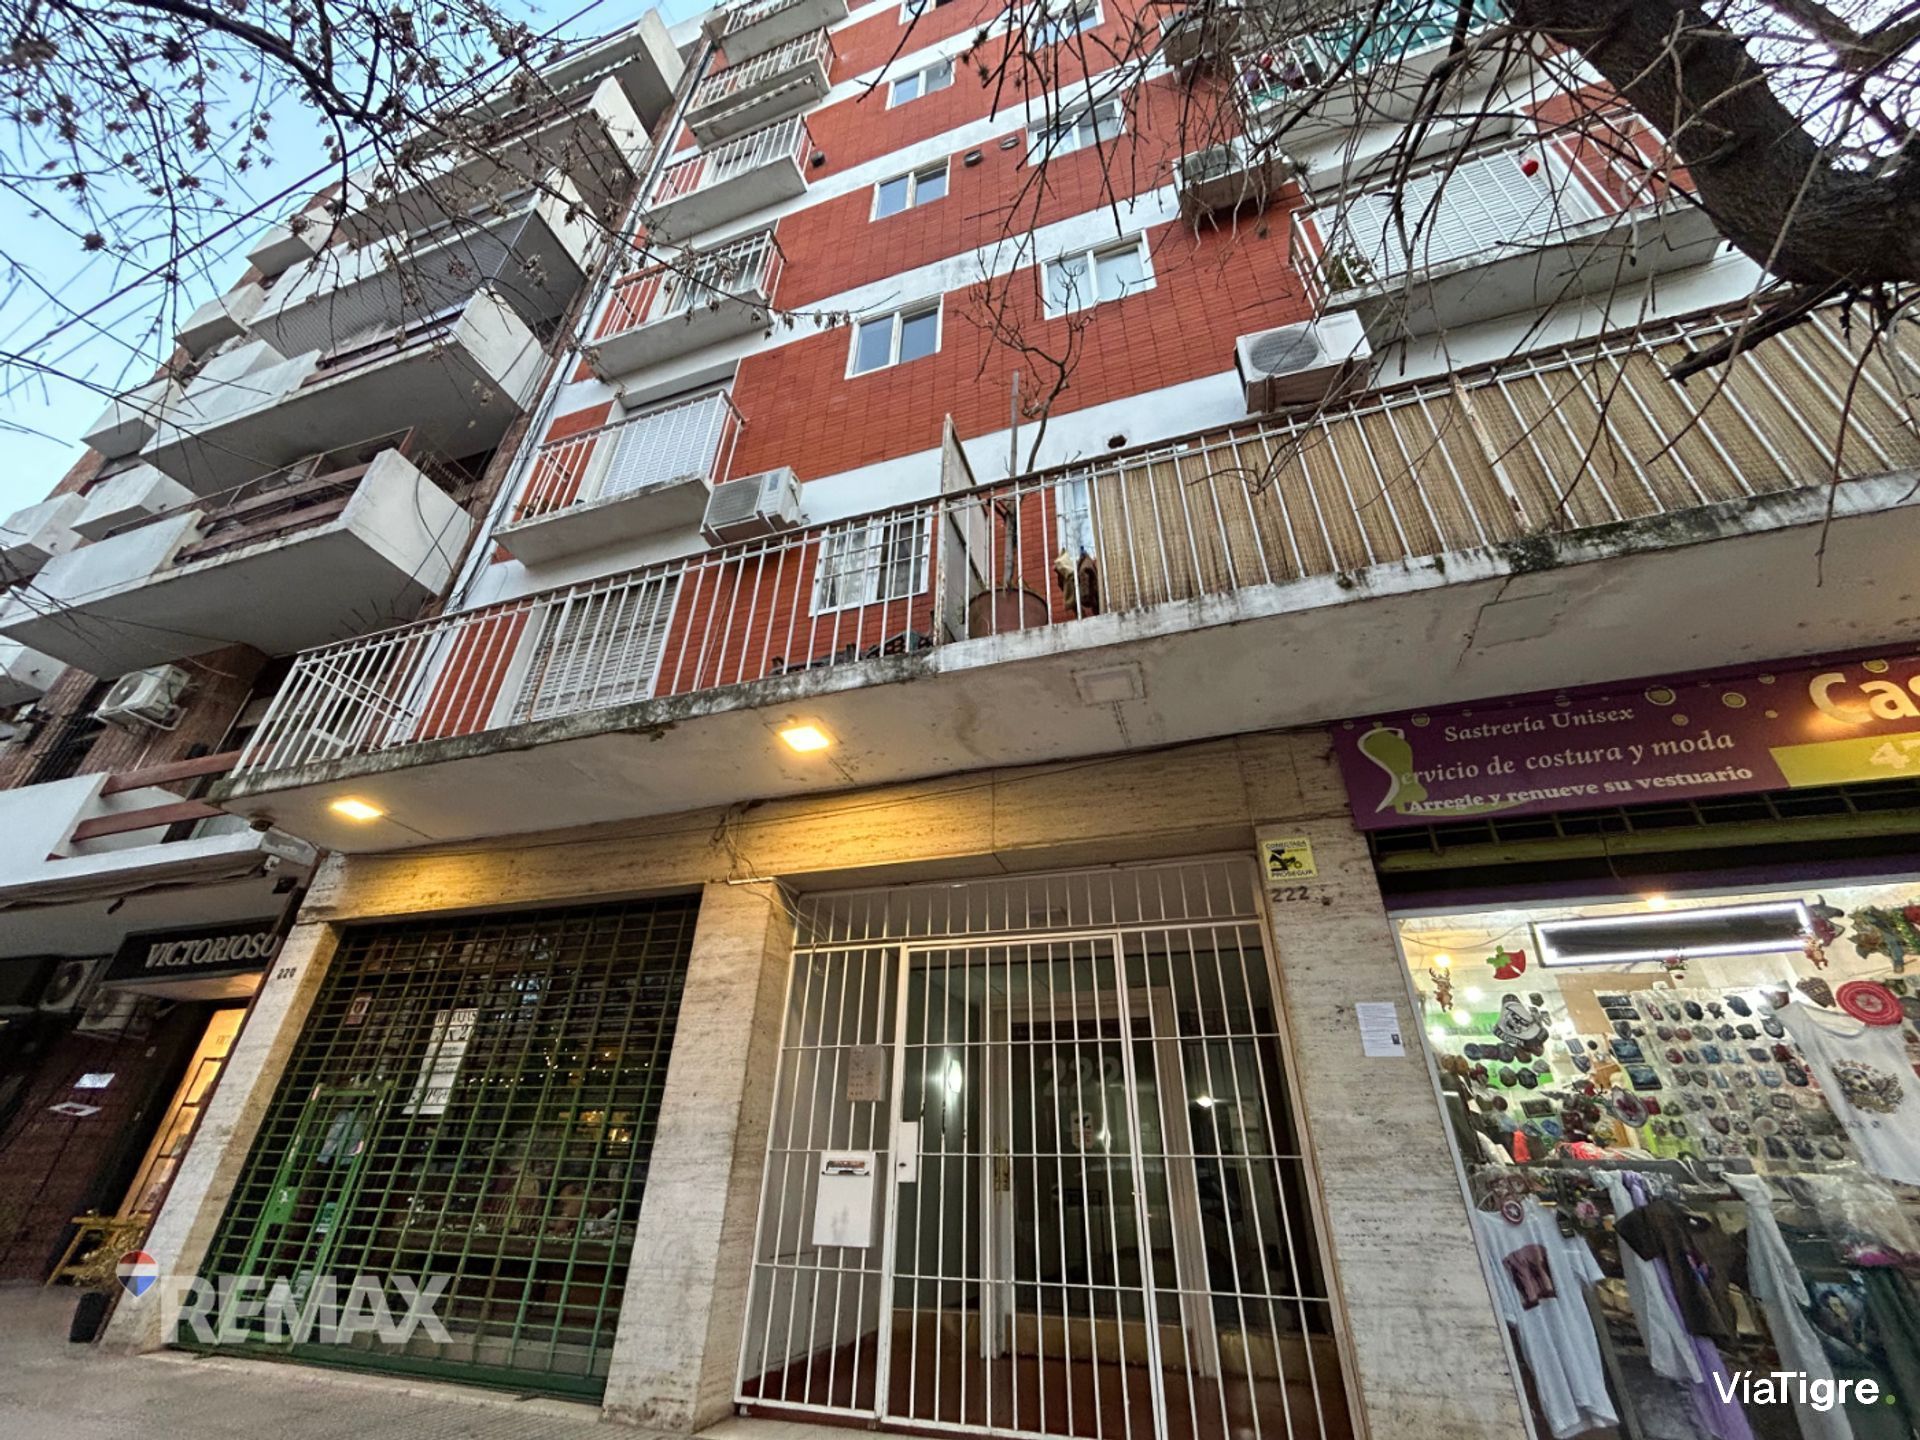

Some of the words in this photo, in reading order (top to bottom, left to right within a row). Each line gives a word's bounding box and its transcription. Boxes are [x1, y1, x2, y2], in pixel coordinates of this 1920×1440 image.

[1444, 716, 1546, 743] Sastrería
[1551, 707, 1635, 729] Unisex
[1487, 755, 1516, 777] de
[1526, 746, 1623, 770] costura
[1628, 743, 1644, 766] y
[1651, 729, 1736, 757] moda
[1409, 793, 1485, 814] Arregle
[1488, 792, 1503, 807] y
[1505, 781, 1600, 804] renueve
[1603, 777, 1633, 794] su
[1635, 765, 1753, 790] vestuario
[1271, 885, 1310, 903] 222
[145, 931, 280, 969] VICTORIOSO
[1042, 1055, 1121, 1097] 222
